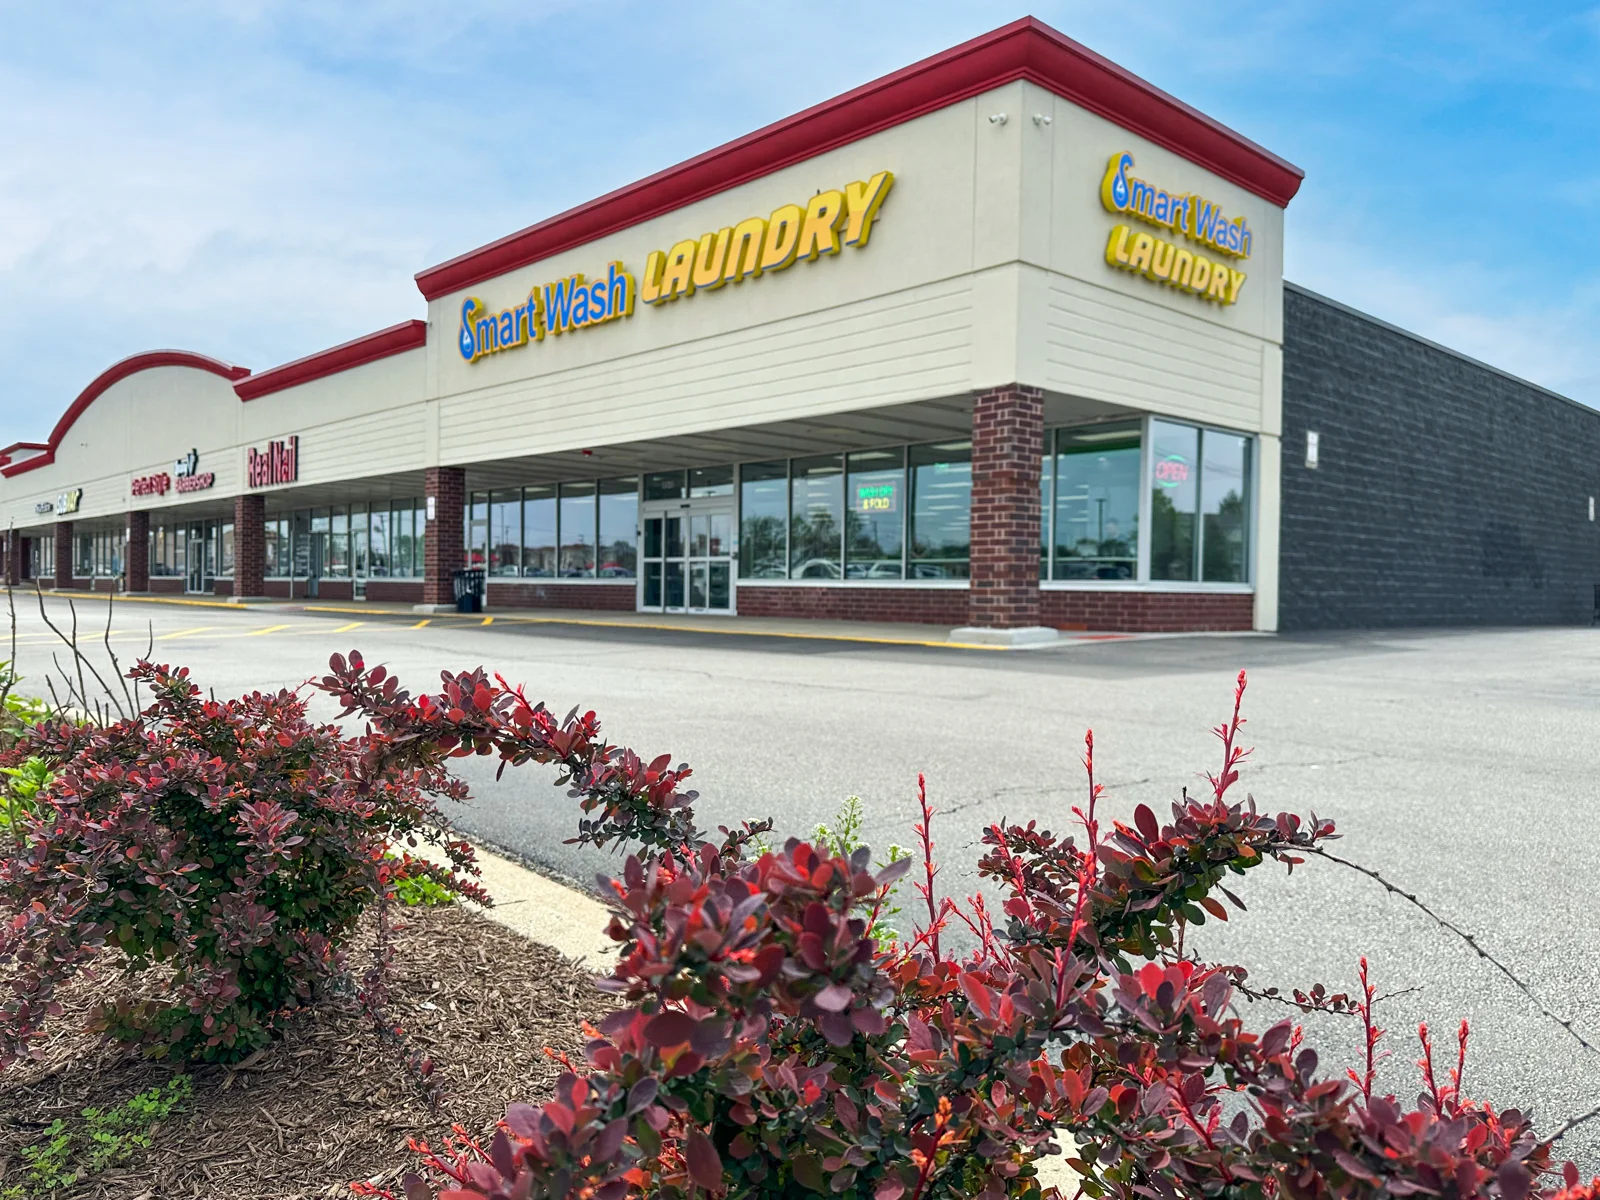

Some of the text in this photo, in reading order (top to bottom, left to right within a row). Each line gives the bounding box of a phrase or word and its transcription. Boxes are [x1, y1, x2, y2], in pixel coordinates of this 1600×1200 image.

[1102, 151, 1253, 260] Smart Wash
[459, 170, 894, 363] Smart Wash LAUNDRY
[1106, 224, 1247, 306] LAUNDRY
[248, 441, 273, 487] Real
[273, 436, 299, 482] Nail
[1156, 461, 1188, 480] OPEN
